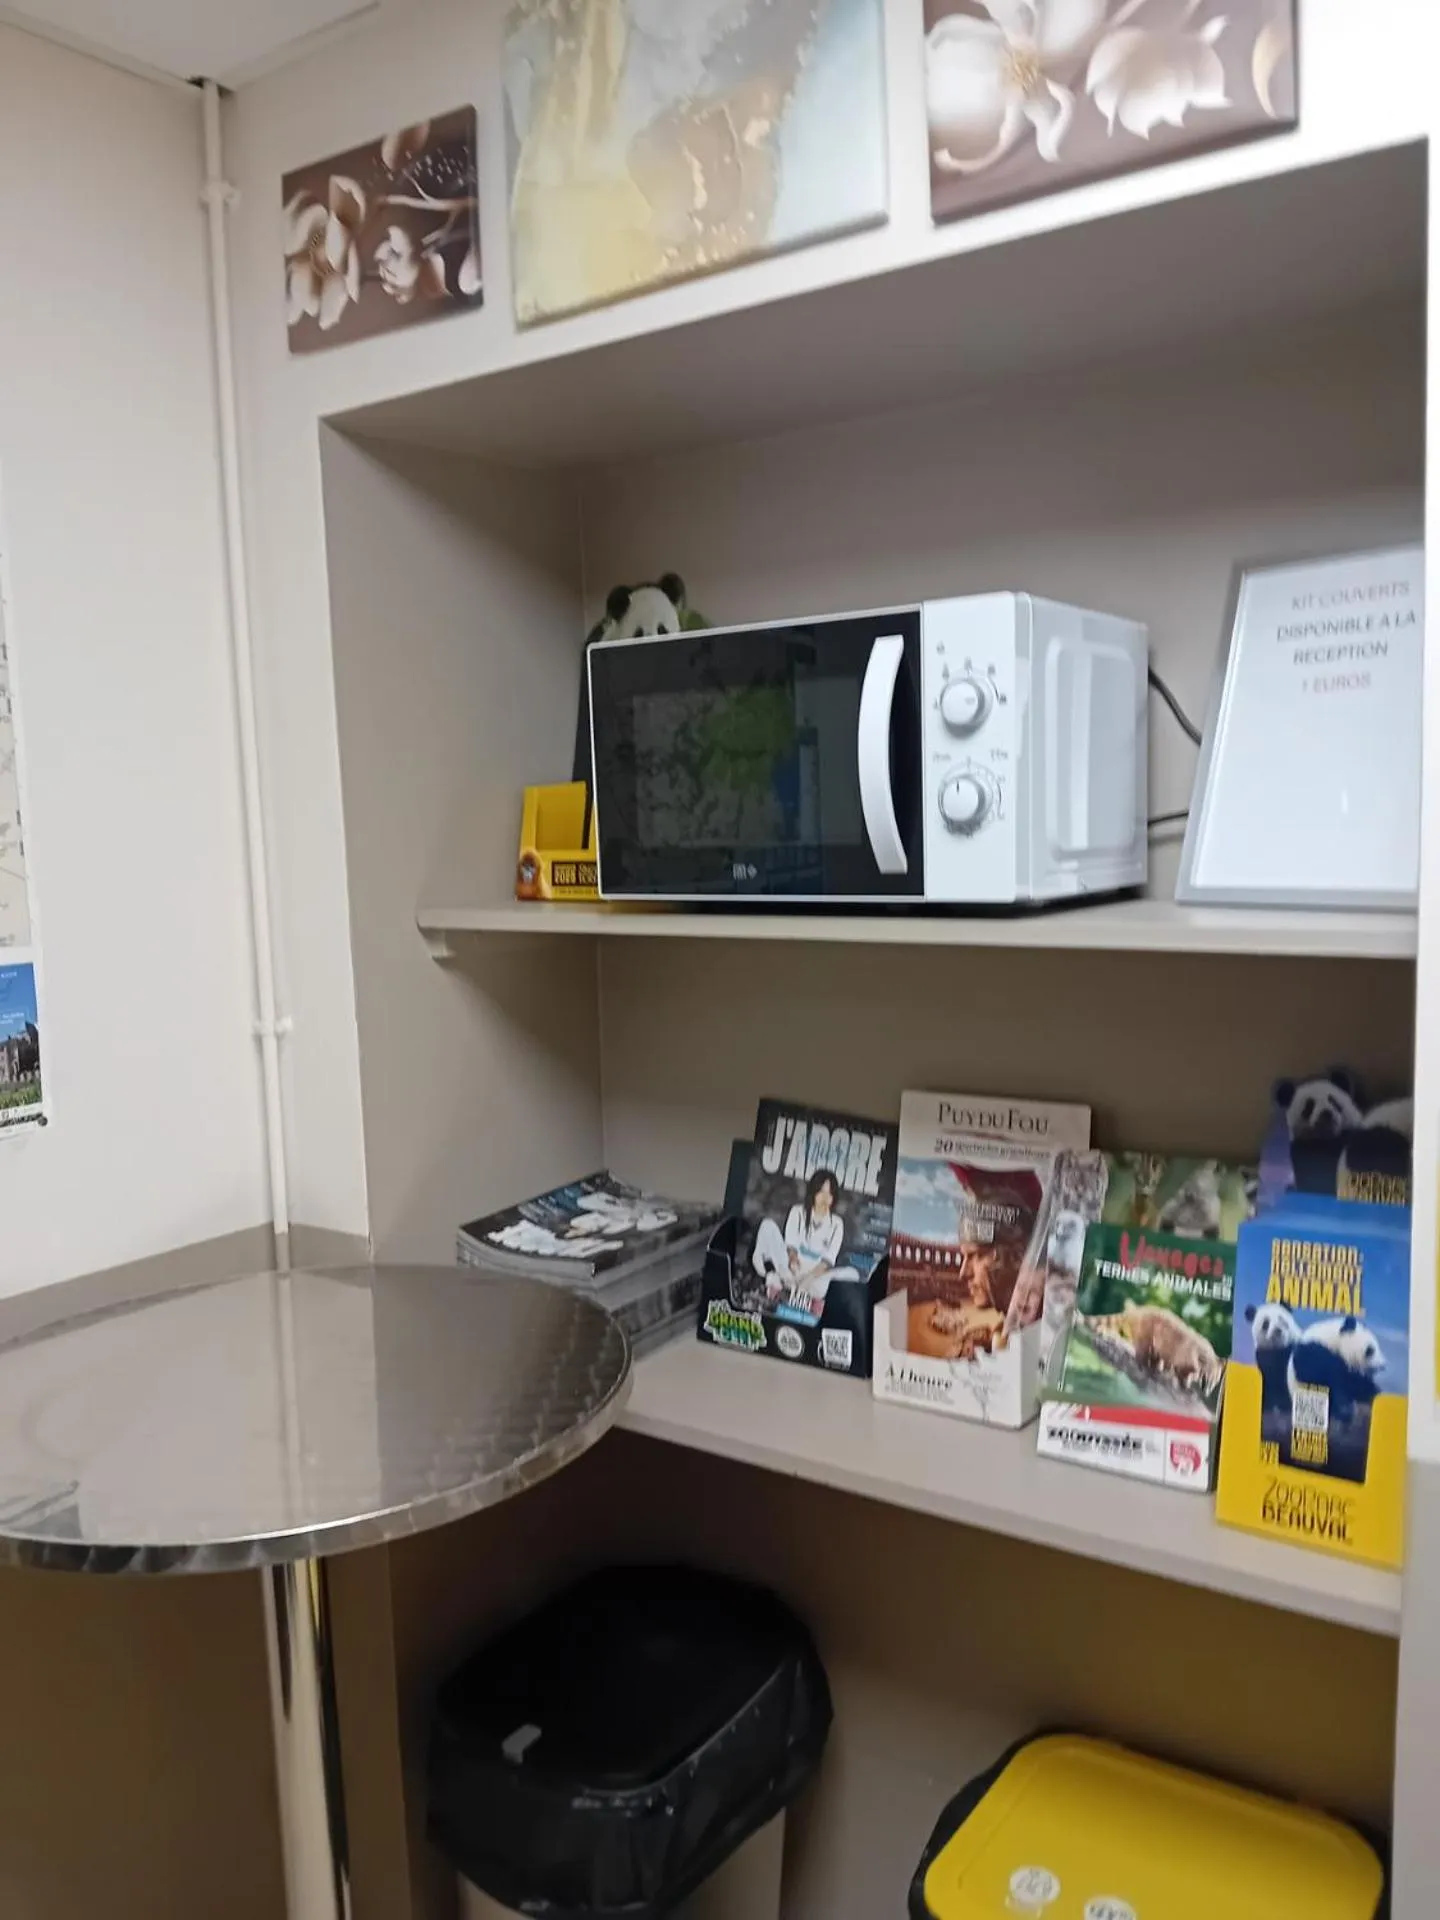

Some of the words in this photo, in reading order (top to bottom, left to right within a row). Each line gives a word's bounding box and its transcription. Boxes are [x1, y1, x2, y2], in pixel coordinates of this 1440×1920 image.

[1318, 581, 1411, 609] COUVERTS
[1276, 613, 1375, 643] DISPONIBLE
[1395, 609, 1417, 628] LA
[1293, 639, 1389, 665] RECEPTION
[1313, 671, 1372, 693] EUROS
[762, 1115, 888, 1198] J'ADORE
[1151, 1271, 1233, 1302] ANIMALES
[1265, 1272, 1366, 1318] ANIMAL
